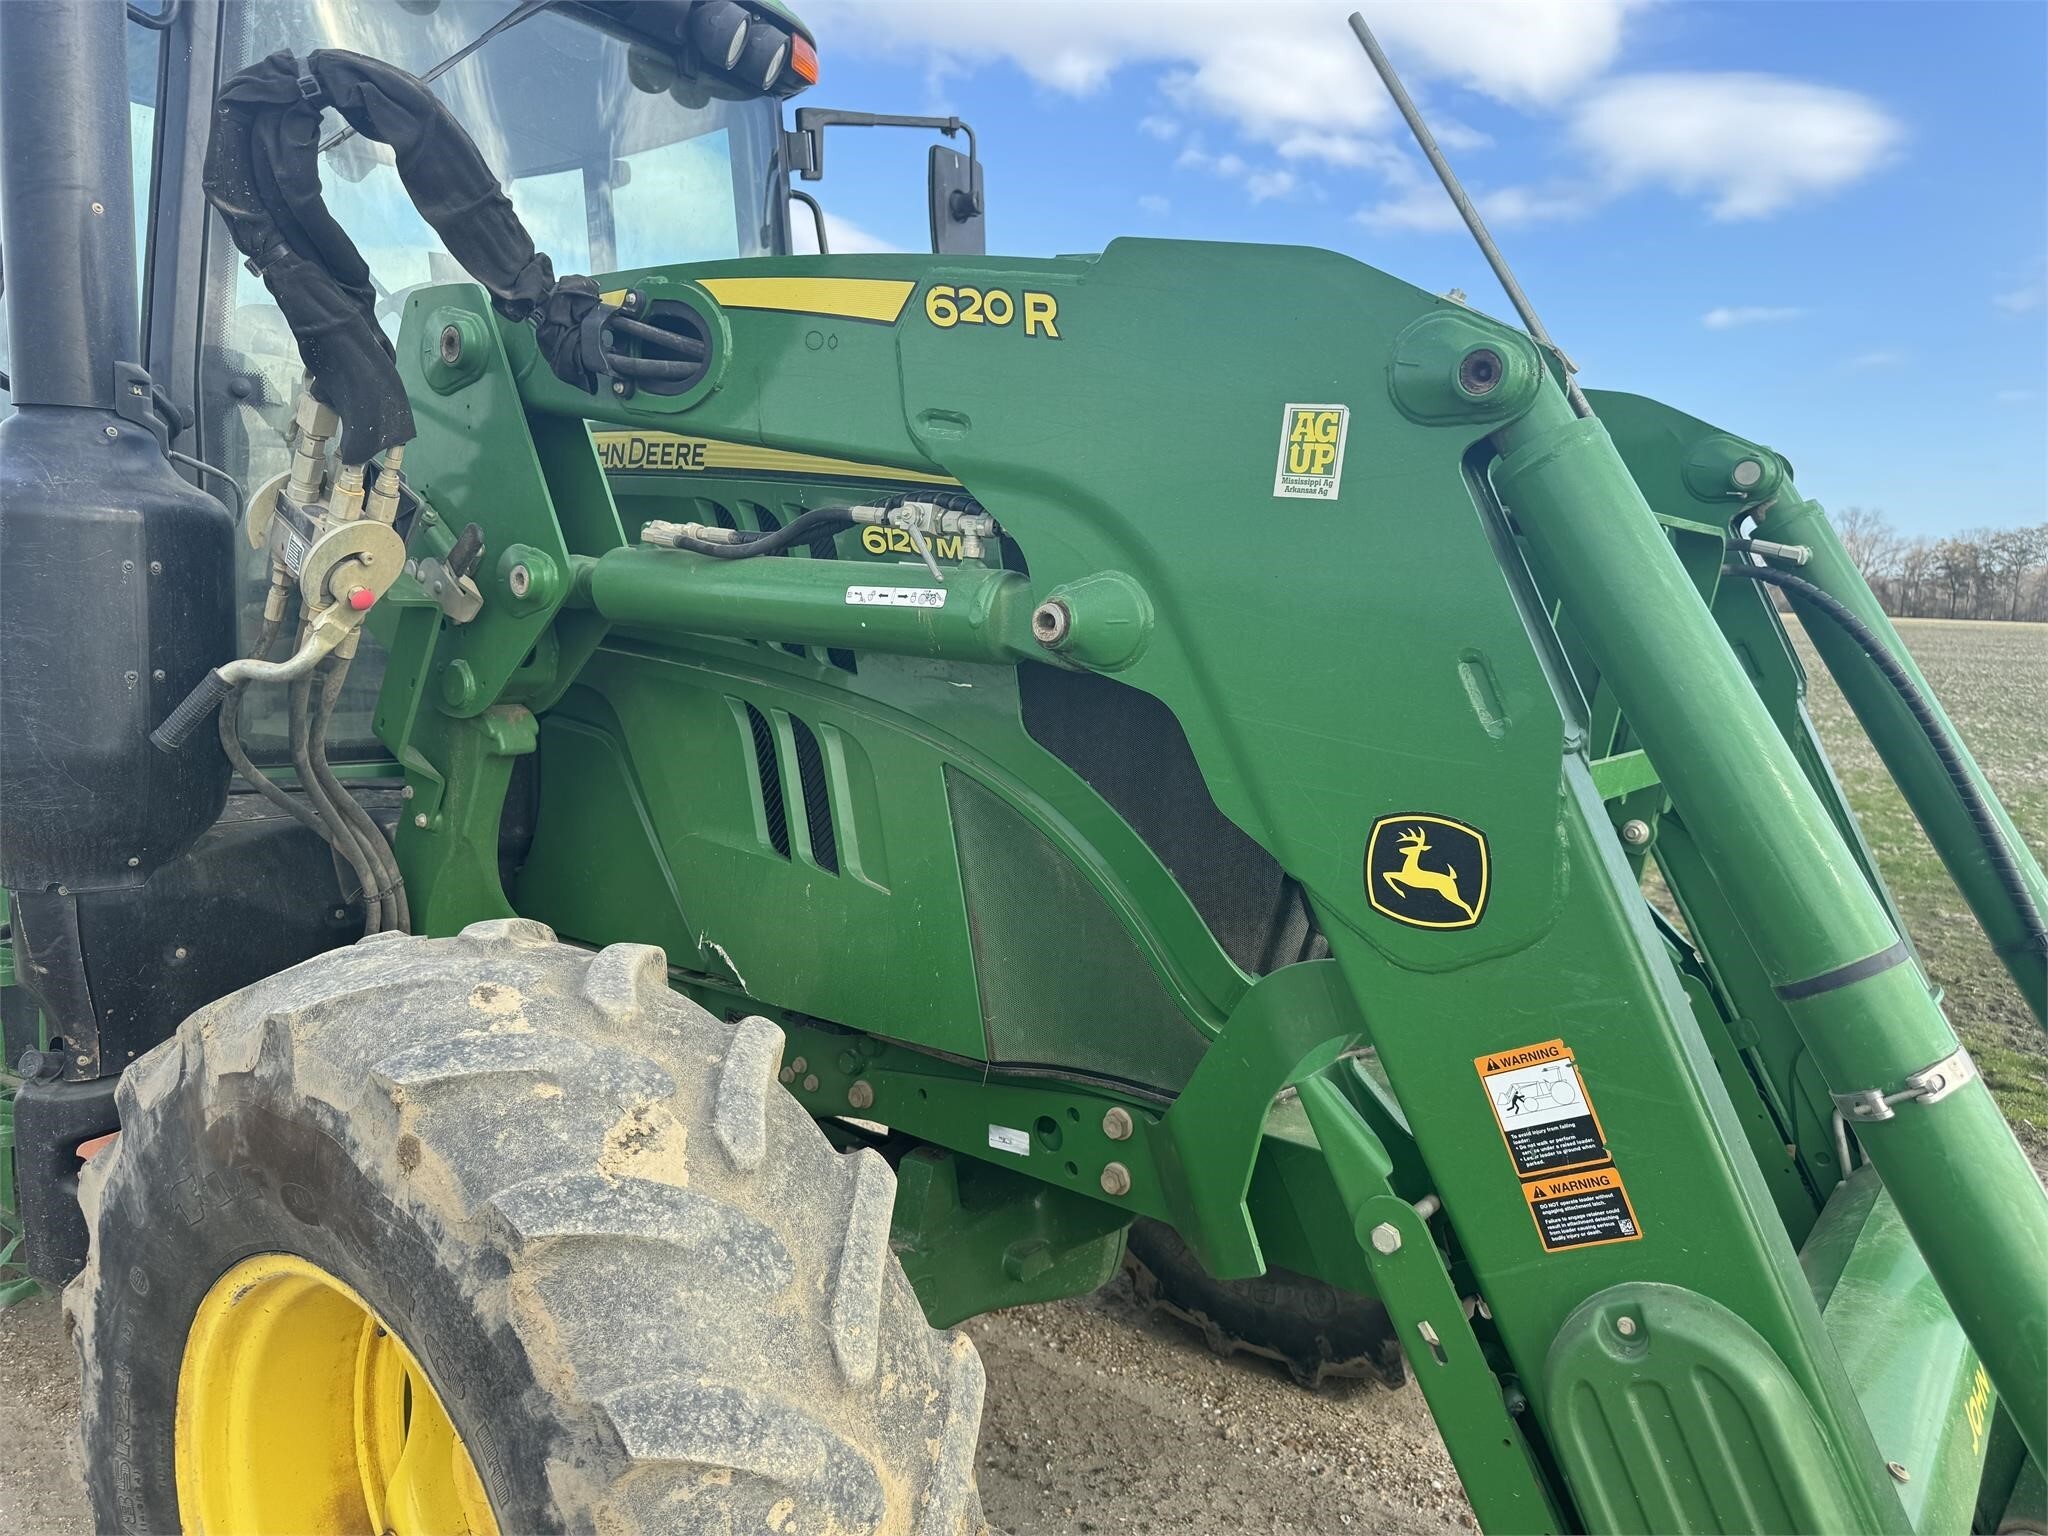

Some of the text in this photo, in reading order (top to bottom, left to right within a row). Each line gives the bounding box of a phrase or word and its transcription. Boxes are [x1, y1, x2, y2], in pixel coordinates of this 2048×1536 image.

[926, 286, 1060, 338] 620 R
[1291, 412, 1338, 443] AG
[598, 443, 625, 465] HN
[1289, 443, 1335, 474] UP
[1282, 477, 1333, 488] Mississippi Ag
[1285, 485, 1328, 496] Arkansas Ag
[936, 535, 963, 560] M
[1500, 1046, 1559, 1068] WARNING
[1559, 1122, 1576, 1130] falling
[1556, 1135, 1576, 1143] perform
[1549, 1175, 1611, 1194] WARNING
[1565, 1203, 1592, 1211] attachment
[1595, 1214, 1619, 1222] detaching
[1964, 1360, 1990, 1456] JOHN
